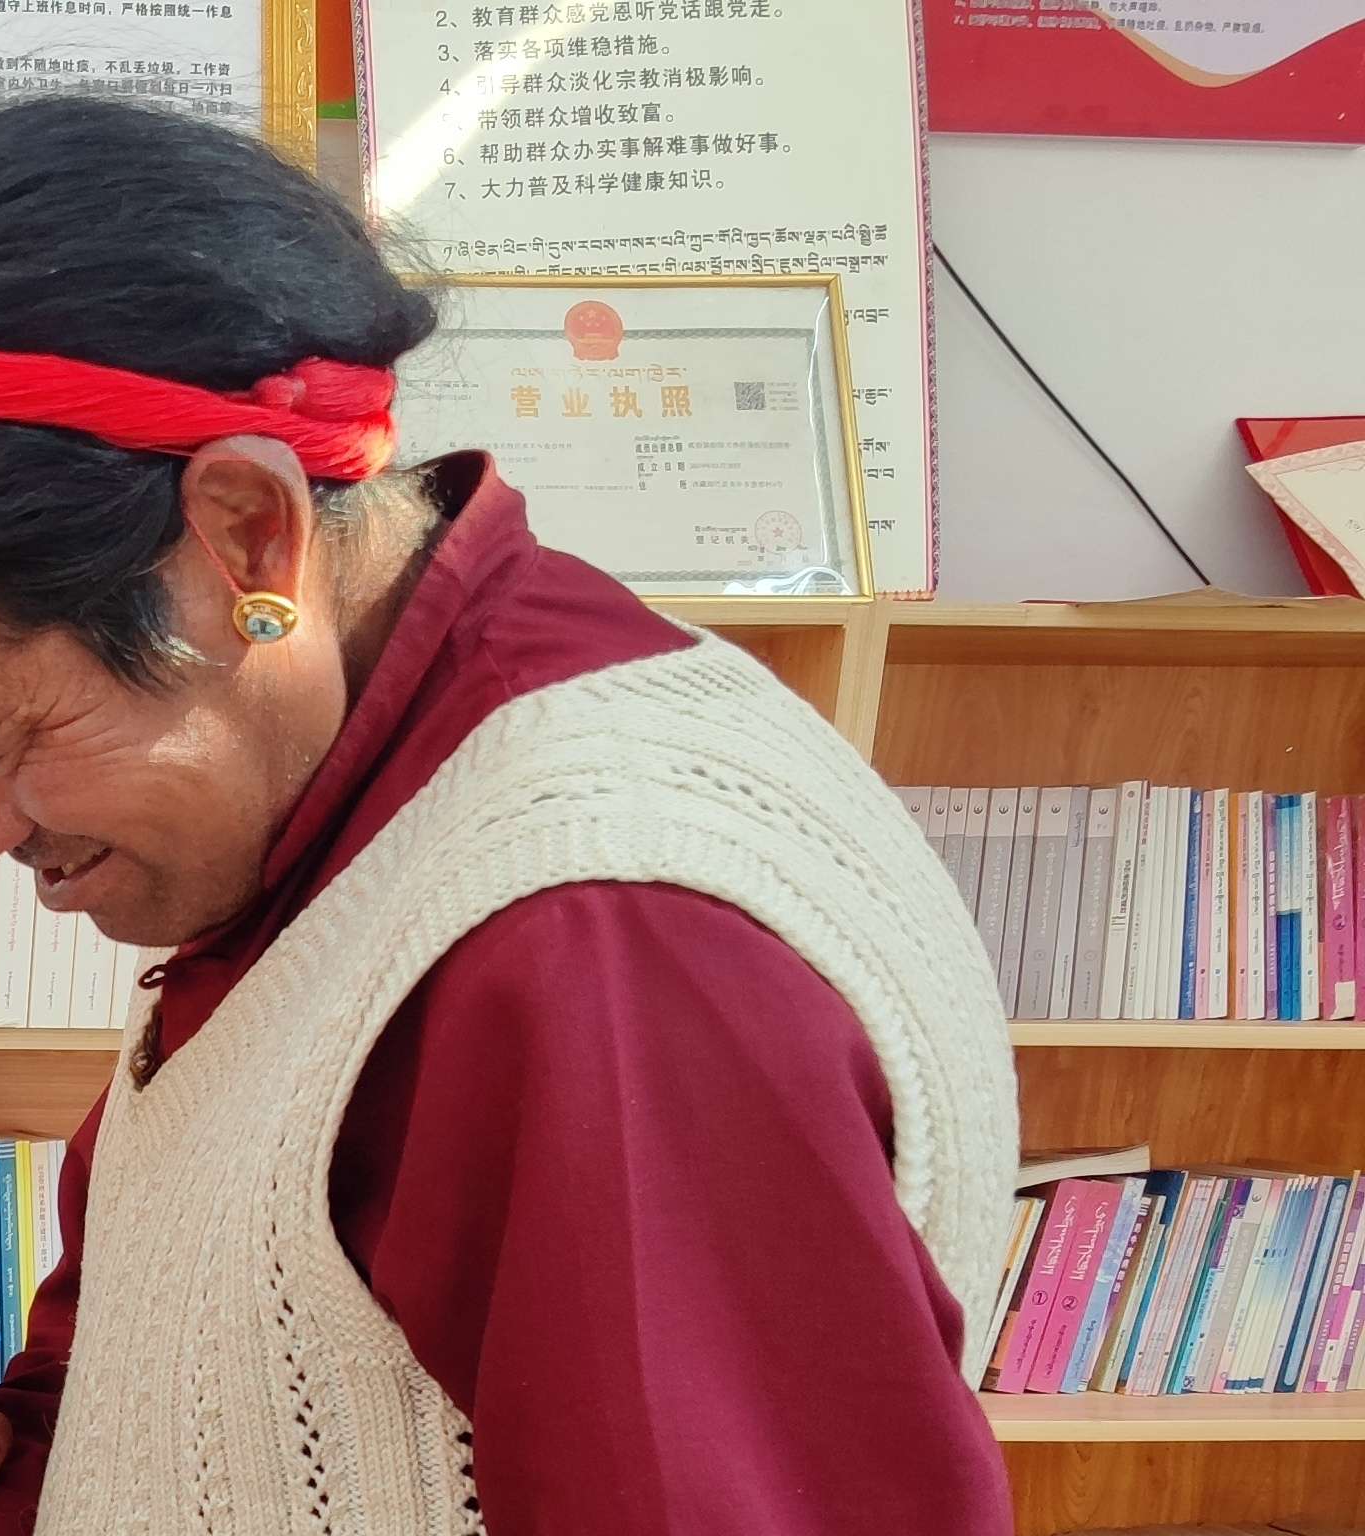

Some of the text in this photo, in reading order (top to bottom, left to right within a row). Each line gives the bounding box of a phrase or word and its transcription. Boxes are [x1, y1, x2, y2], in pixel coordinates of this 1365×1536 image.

[437, 33, 672, 64] 3、落实各项维稳措施。
[439, 66, 765, 97] 4、引导群众淡化宗教消极影响。
[443, 131, 792, 166] 6、帮助群众办实事解难事做好事。
[444, 169, 726, 201] 7、大力普及科学健康知识。
[510, 385, 692, 418] 营业执照
